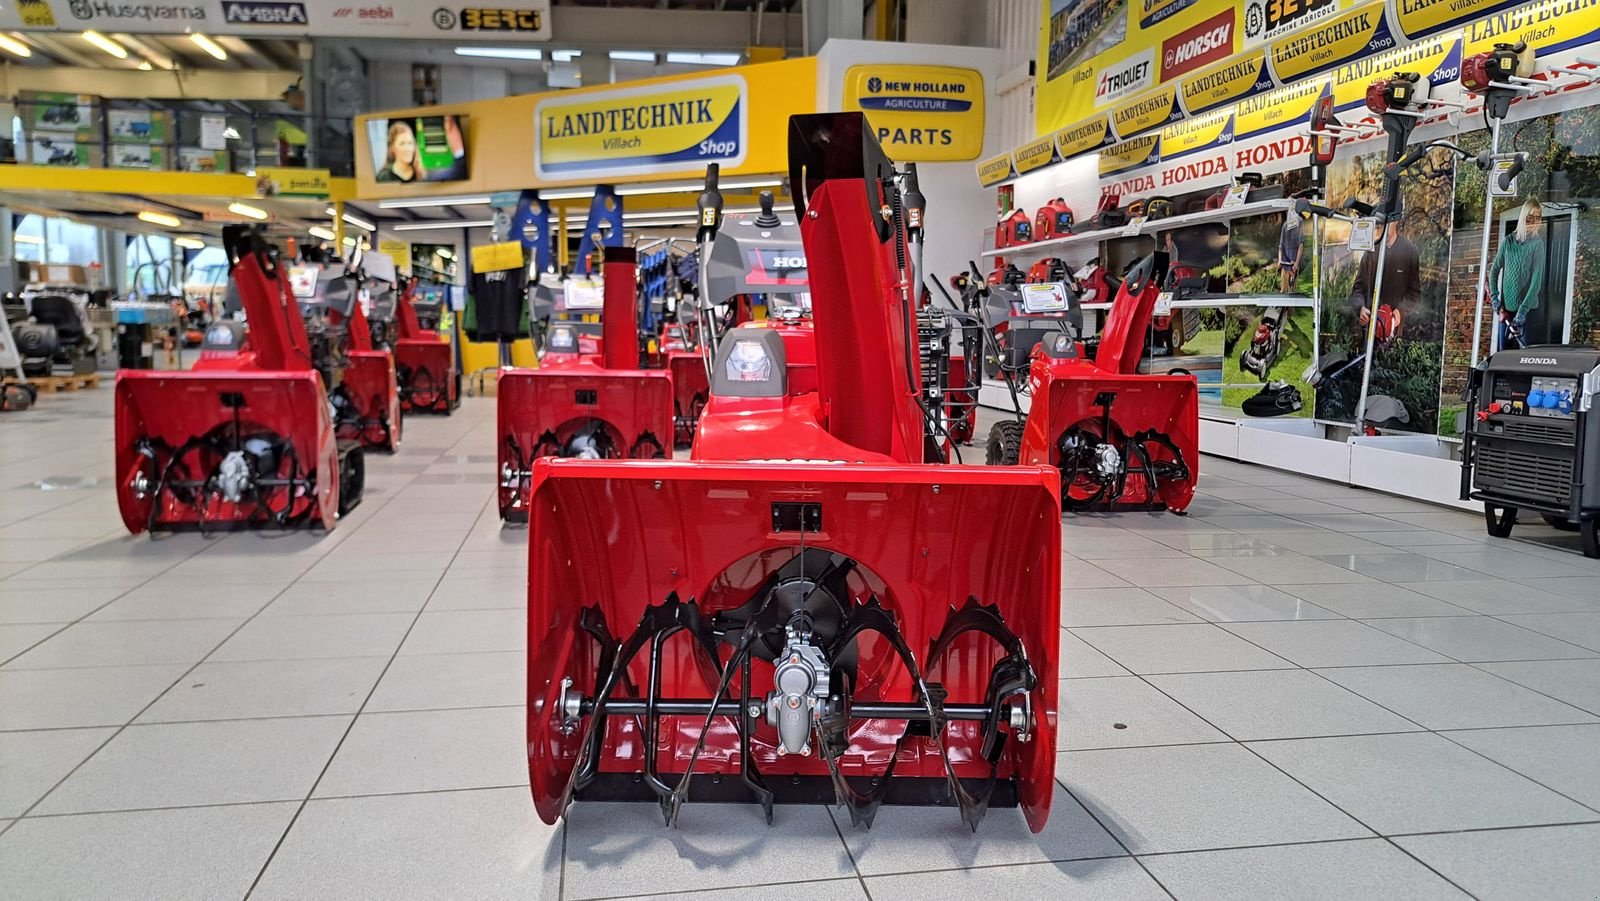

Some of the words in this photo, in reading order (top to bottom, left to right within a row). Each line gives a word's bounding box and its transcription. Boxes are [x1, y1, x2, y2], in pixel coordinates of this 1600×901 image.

[97, 1, 206, 21] Husqvarna
[227, 3, 306, 22] AMBRA
[358, 6, 394, 19] aebi
[1300, 5, 1336, 26] AGRICOLE
[1275, 12, 1372, 63] LANDTECHNIK
[1519, 24, 1556, 43] Villach
[1174, 23, 1231, 65] HORSCH
[1369, 36, 1392, 51] Shop
[1309, 48, 1334, 63] Villach
[1072, 66, 1093, 86] Villach
[1184, 58, 1257, 98] LANDTECHNIK
[1433, 67, 1458, 82] Shop
[885, 82, 911, 92] NEW
[913, 82, 965, 94] HOLLAND
[1211, 86, 1229, 99] Villach
[1255, 79, 1272, 92] Shop
[884, 99, 947, 110] AGRICULTURE
[1115, 92, 1170, 125] LANDTECHNIK
[547, 98, 713, 139] LANDTECHNIK
[1263, 109, 1283, 121] Villach
[878, 127, 952, 145] PARTS
[1059, 119, 1104, 147] LANDTECHNIK
[1218, 133, 1232, 144] Shop
[602, 135, 642, 151] Villach
[699, 139, 736, 156] Shop
[1100, 136, 1153, 160] LANDTECHNIK
[1161, 156, 1228, 187] HONDA
[1101, 174, 1155, 198] HONDA
[1519, 357, 1558, 365] HONDA
